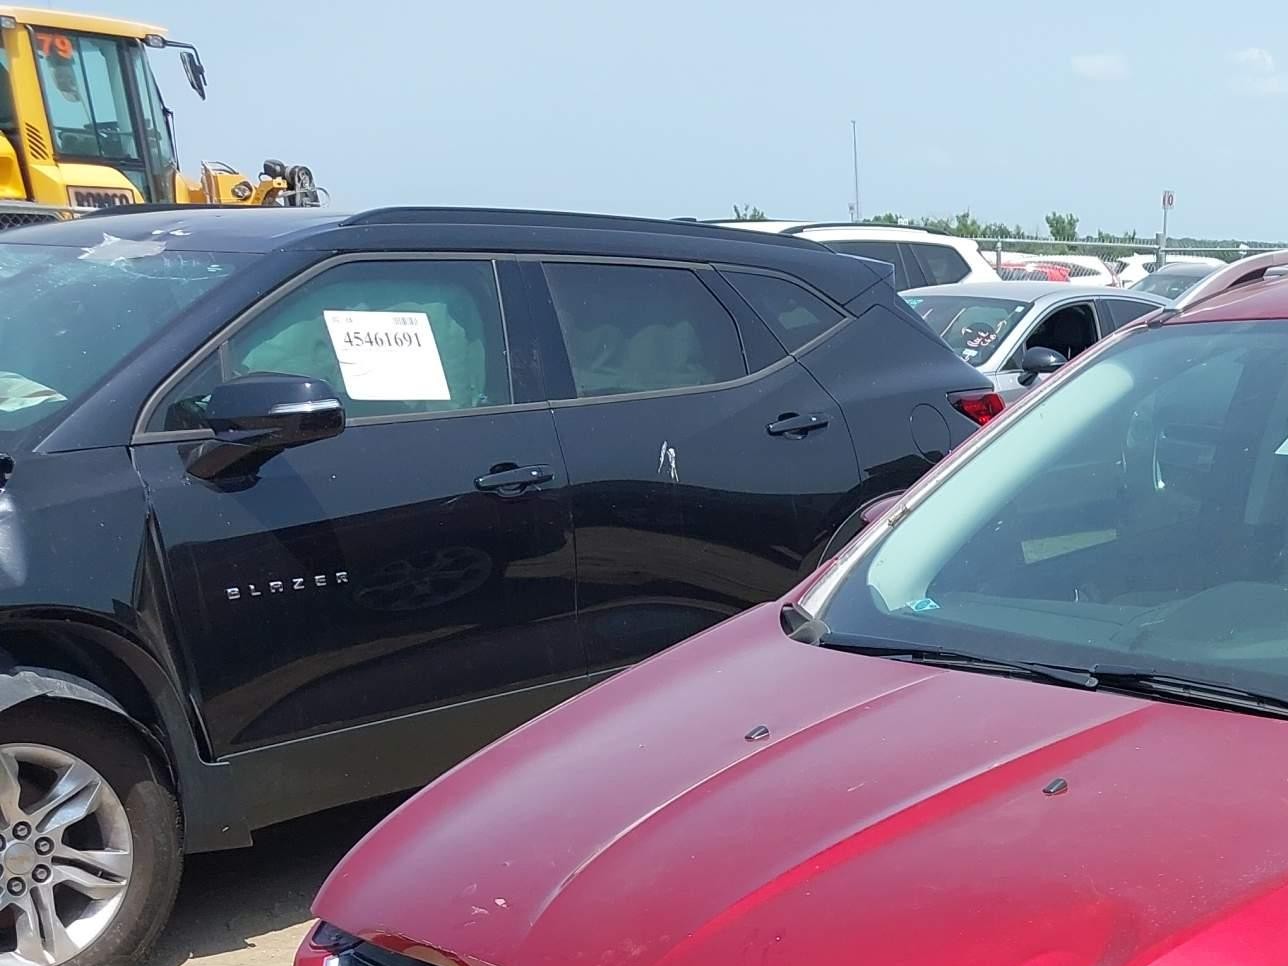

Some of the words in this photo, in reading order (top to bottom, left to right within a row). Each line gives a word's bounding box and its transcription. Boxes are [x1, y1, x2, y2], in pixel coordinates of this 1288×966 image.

[35, 33, 73, 59] 79
[343, 331, 422, 348] 45461691
[226, 571, 349, 600] BLAZER
